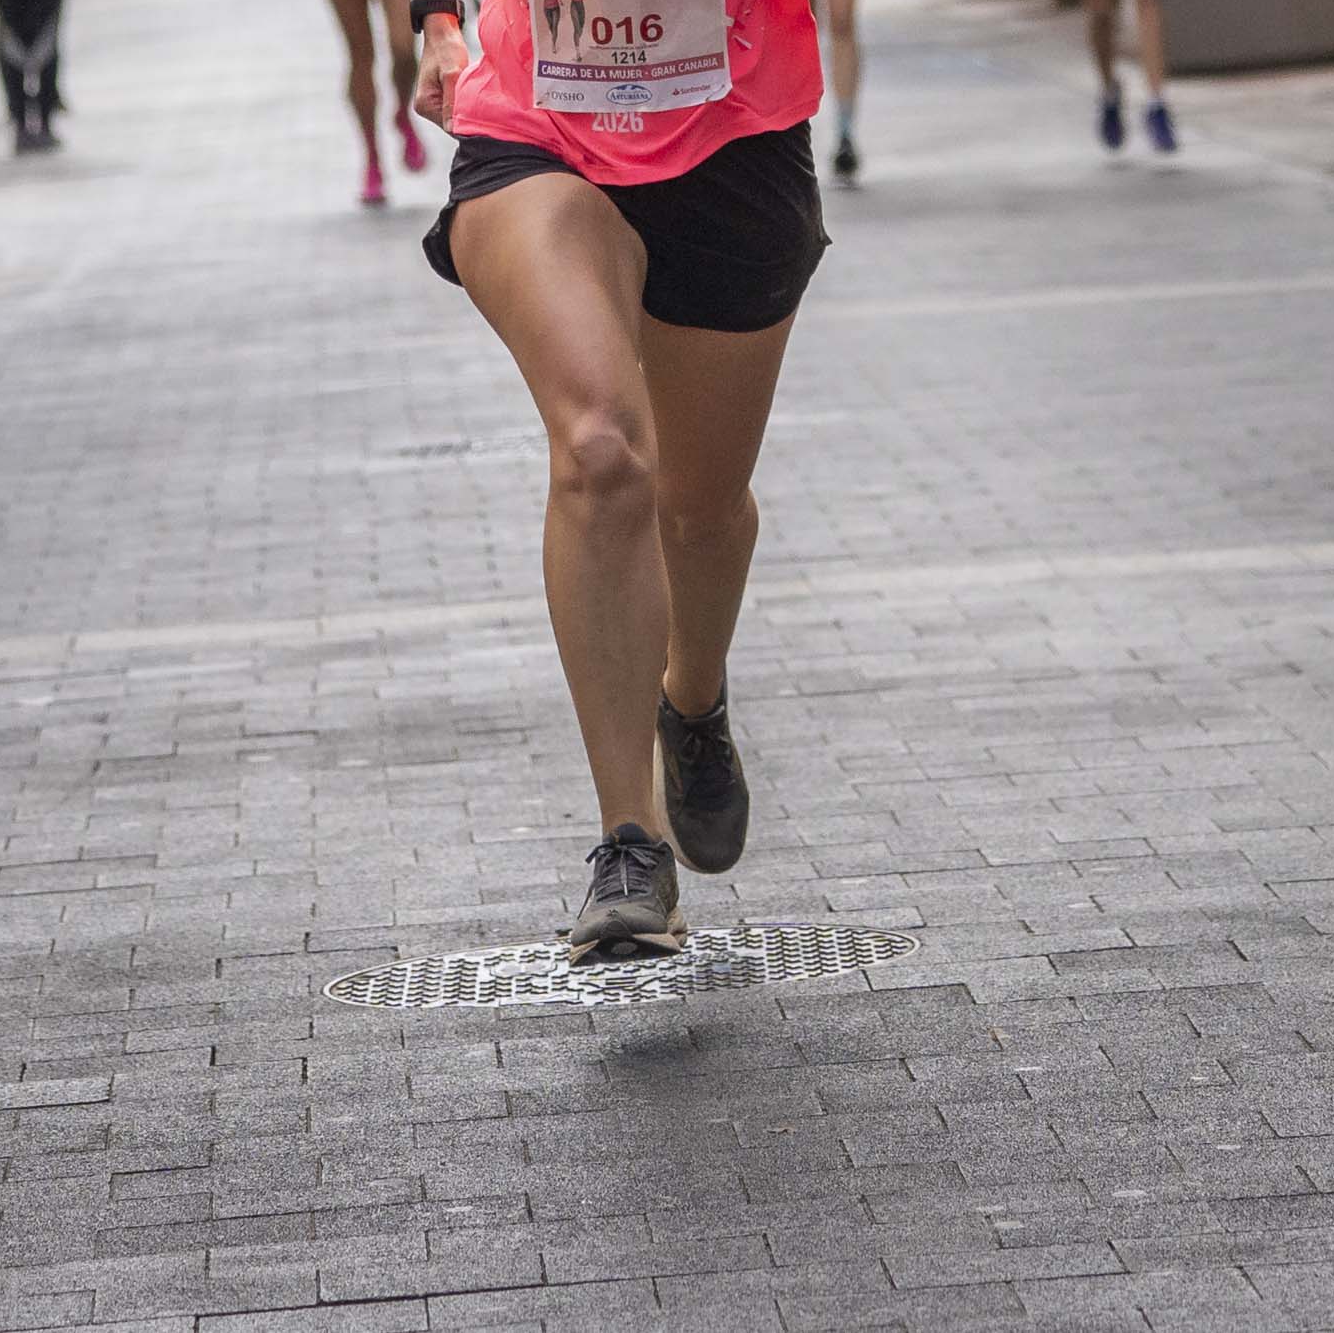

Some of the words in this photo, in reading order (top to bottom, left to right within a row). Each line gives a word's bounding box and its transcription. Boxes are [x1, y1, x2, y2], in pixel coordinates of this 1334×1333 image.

[591, 13, 664, 45] 016
[611, 50, 647, 64] 1214
[541, 64, 578, 78] CARRERA
[580, 68, 593, 78] DE
[595, 69, 607, 79] LA
[609, 67, 643, 79] MUJER
[651, 63, 676, 78] GRAN
[678, 57, 718, 73] CANARIA
[551, 92, 585, 102] OYSHO
[592, 112, 644, 133] 2026
